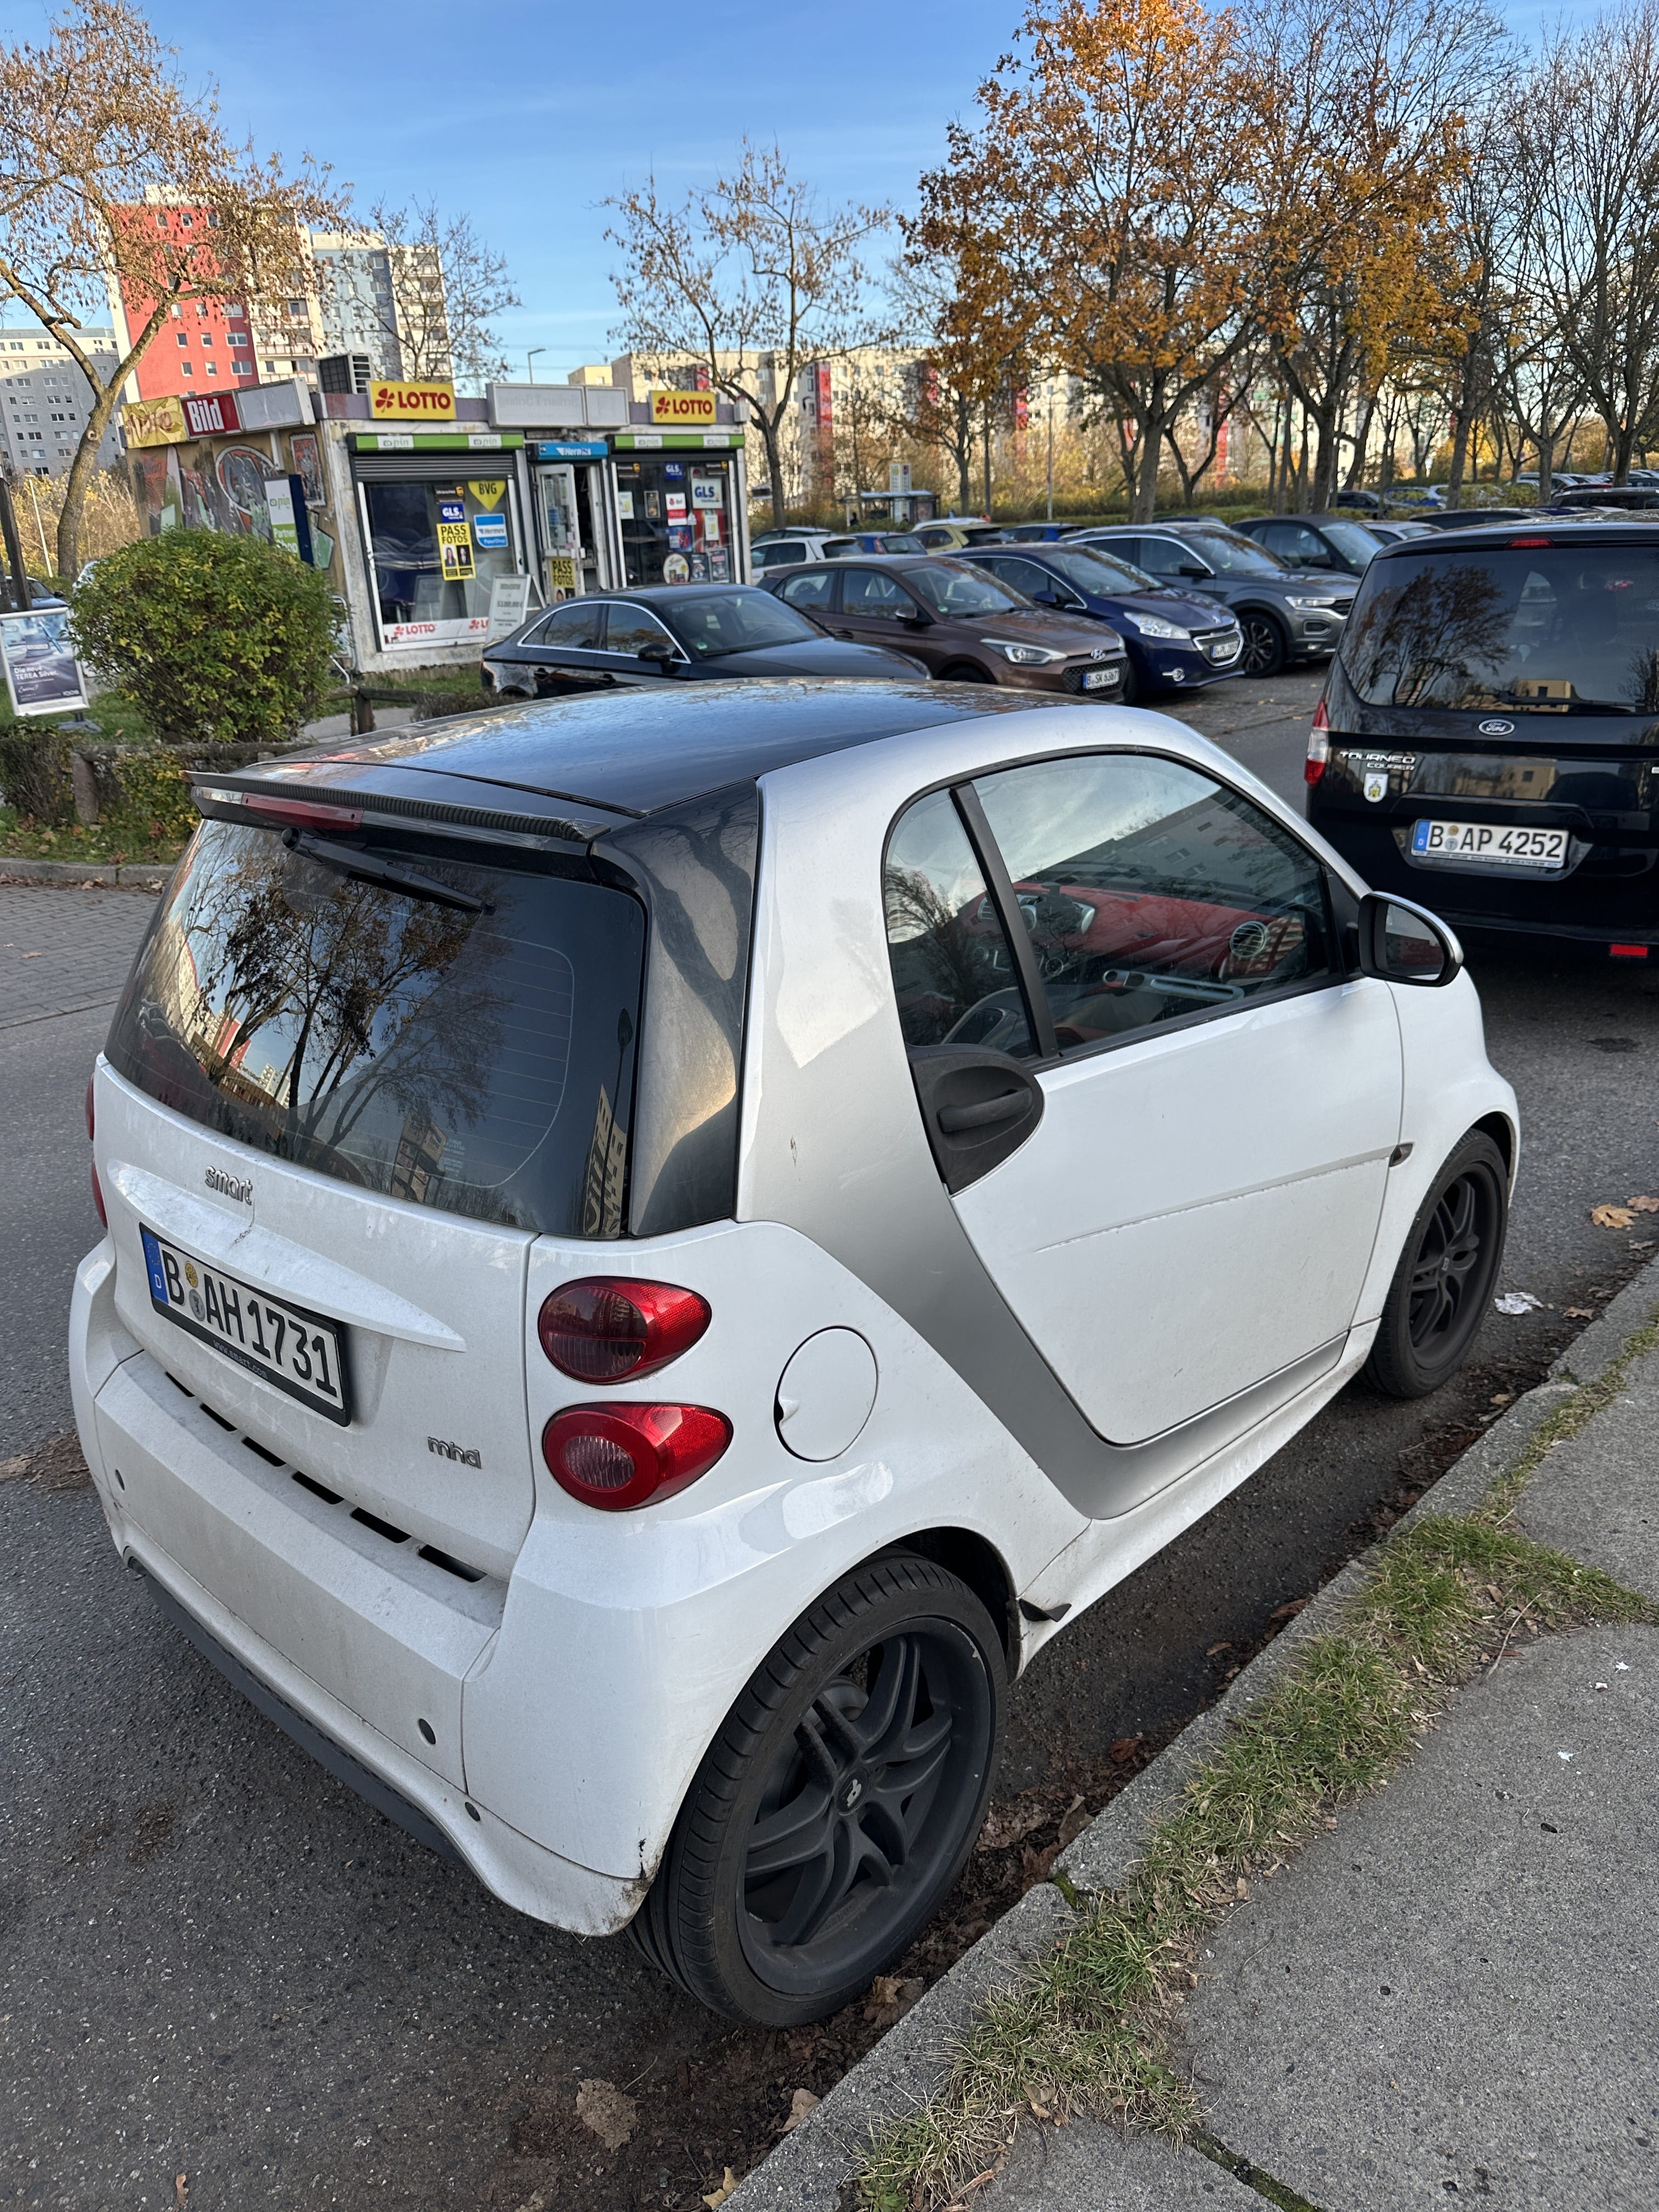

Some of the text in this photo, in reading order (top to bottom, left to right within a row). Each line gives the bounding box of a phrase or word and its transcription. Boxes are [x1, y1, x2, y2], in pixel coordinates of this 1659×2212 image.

[398, 391, 451, 409] LOTTO
[673, 398, 712, 415] LOTTO
[187, 398, 224, 432] Bild
[665, 465, 680, 473] GLS
[478, 483, 496, 495] BVG
[695, 486, 715, 498] GLS
[278, 494, 290, 510] pin
[442, 506, 459, 517] GLS
[441, 525, 466, 536] PASS
[442, 535, 468, 544] FOTOS
[552, 560, 572, 574] PASS
[554, 575, 573, 585] FOTOS
[406, 624, 436, 635] LOTTO
[1486, 722, 1507, 732] Ford
[1340, 750, 1416, 764] TOURNEO
[1429, 826, 1444, 848] B
[1460, 828, 1492, 851] AP
[1499, 831, 1562, 858] 4252
[205, 1165, 253, 1205] smart
[155, 1273, 162, 1289] D
[162, 1249, 185, 1306] B
[213, 1340, 268, 1379] www.smart.com
[427, 1436, 482, 1469] mhd
